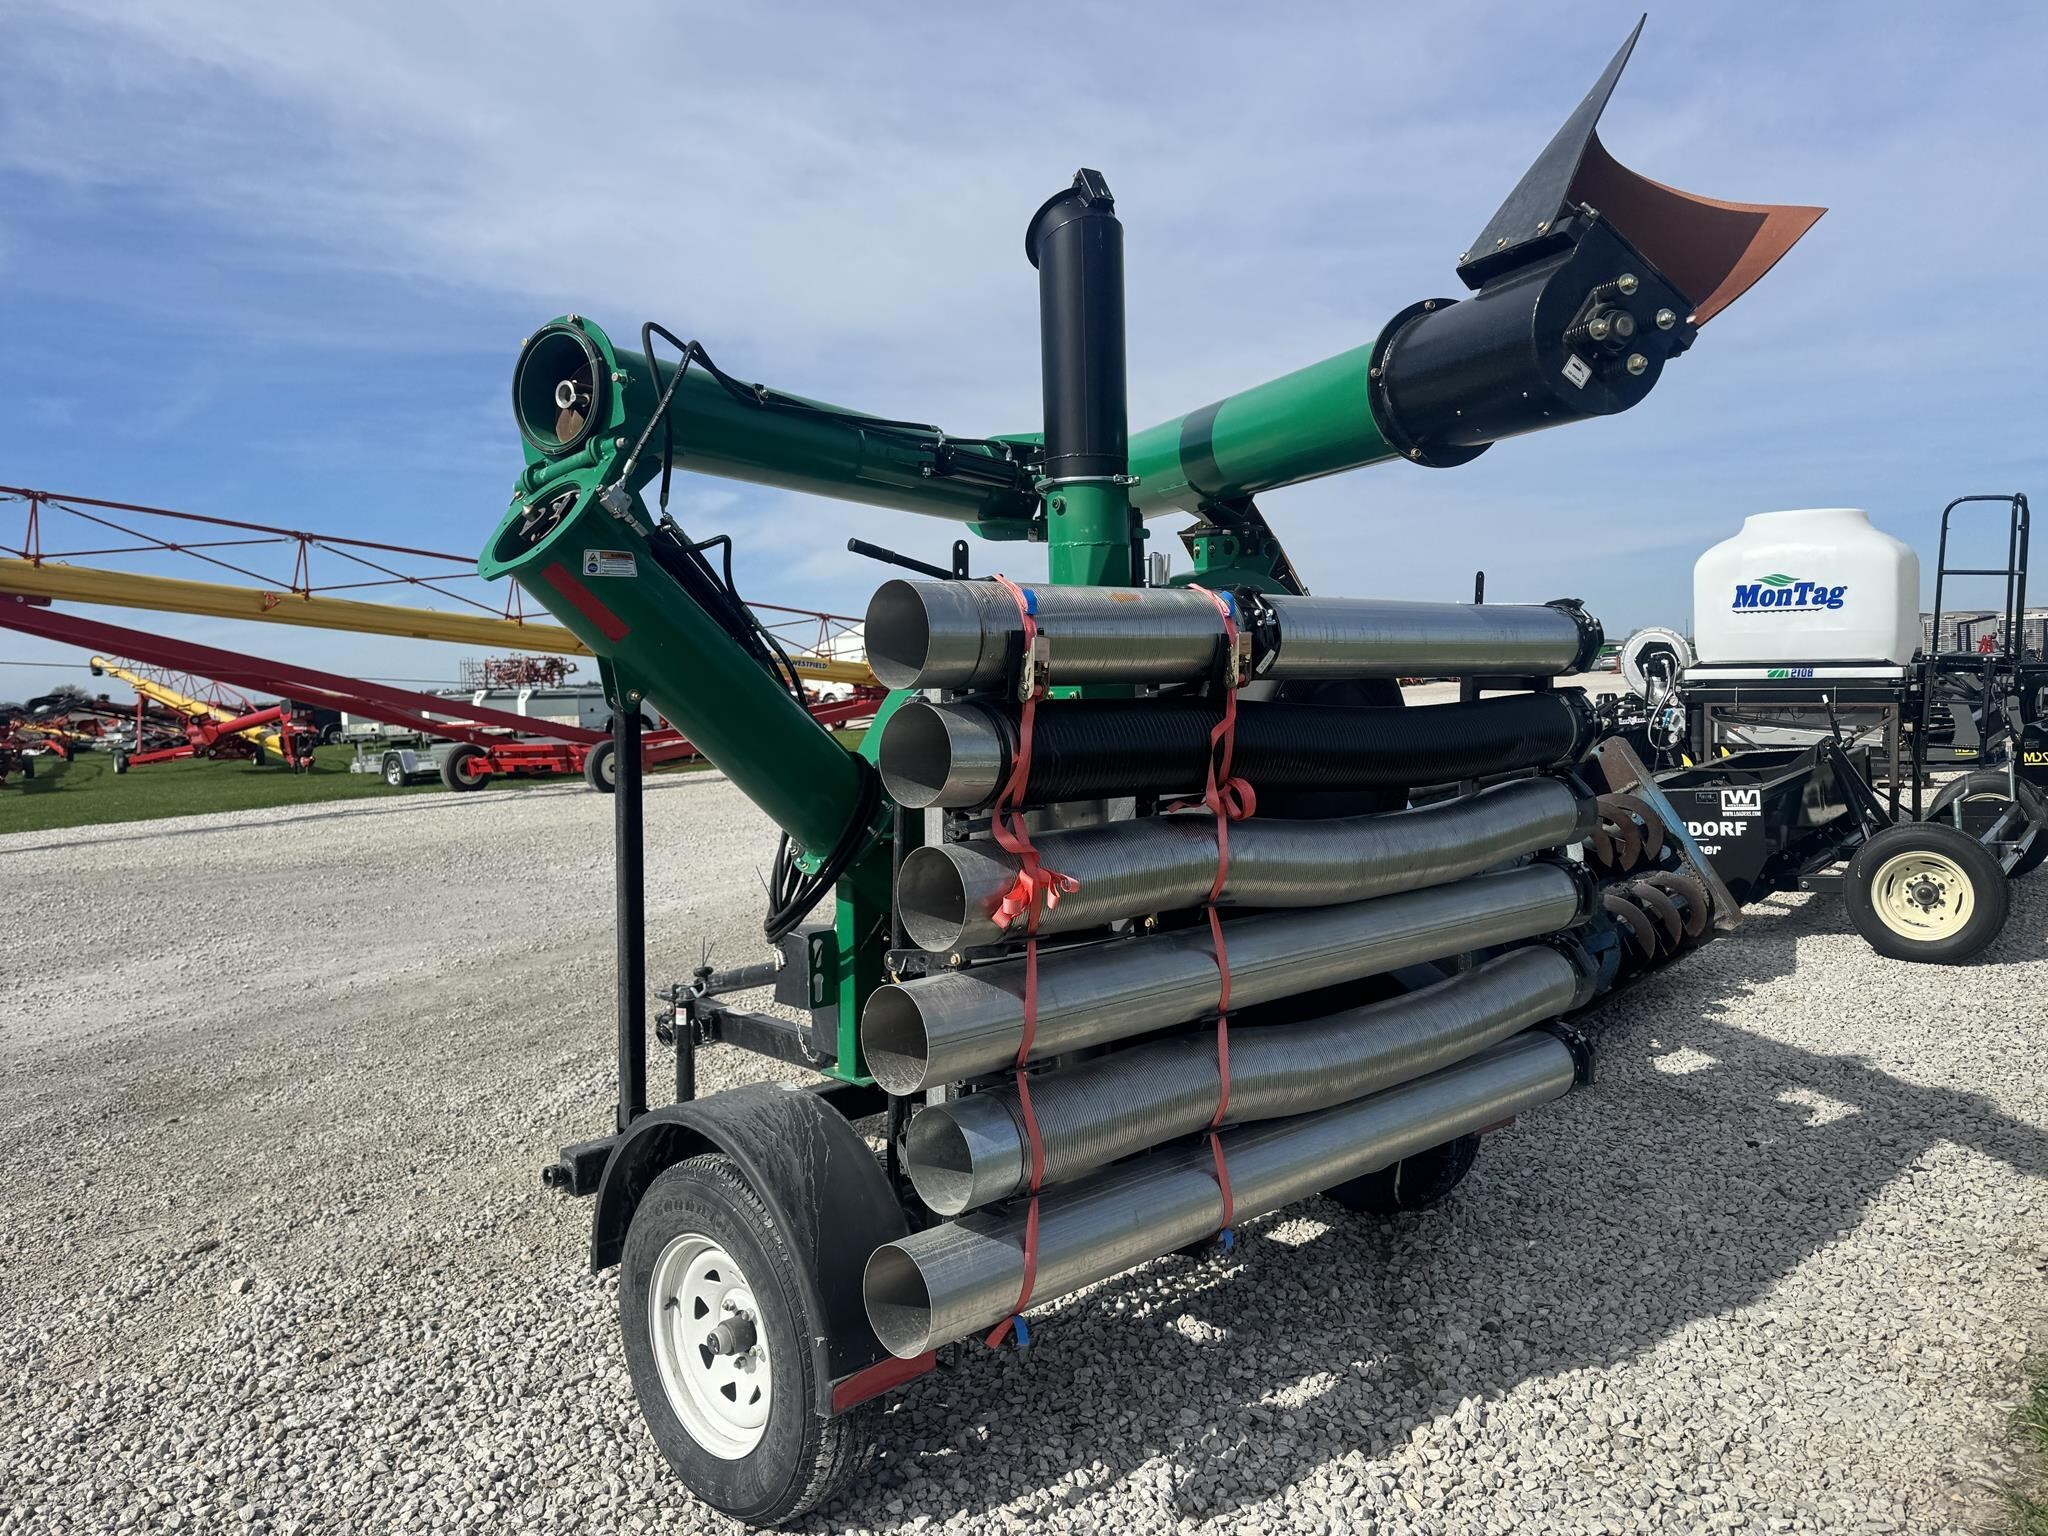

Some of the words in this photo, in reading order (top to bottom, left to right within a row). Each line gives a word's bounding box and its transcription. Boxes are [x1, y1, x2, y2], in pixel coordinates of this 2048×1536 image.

[1732, 581, 1845, 609] MonTag
[1790, 668, 1814, 677] 2108
[1683, 821, 1748, 836] DORF
